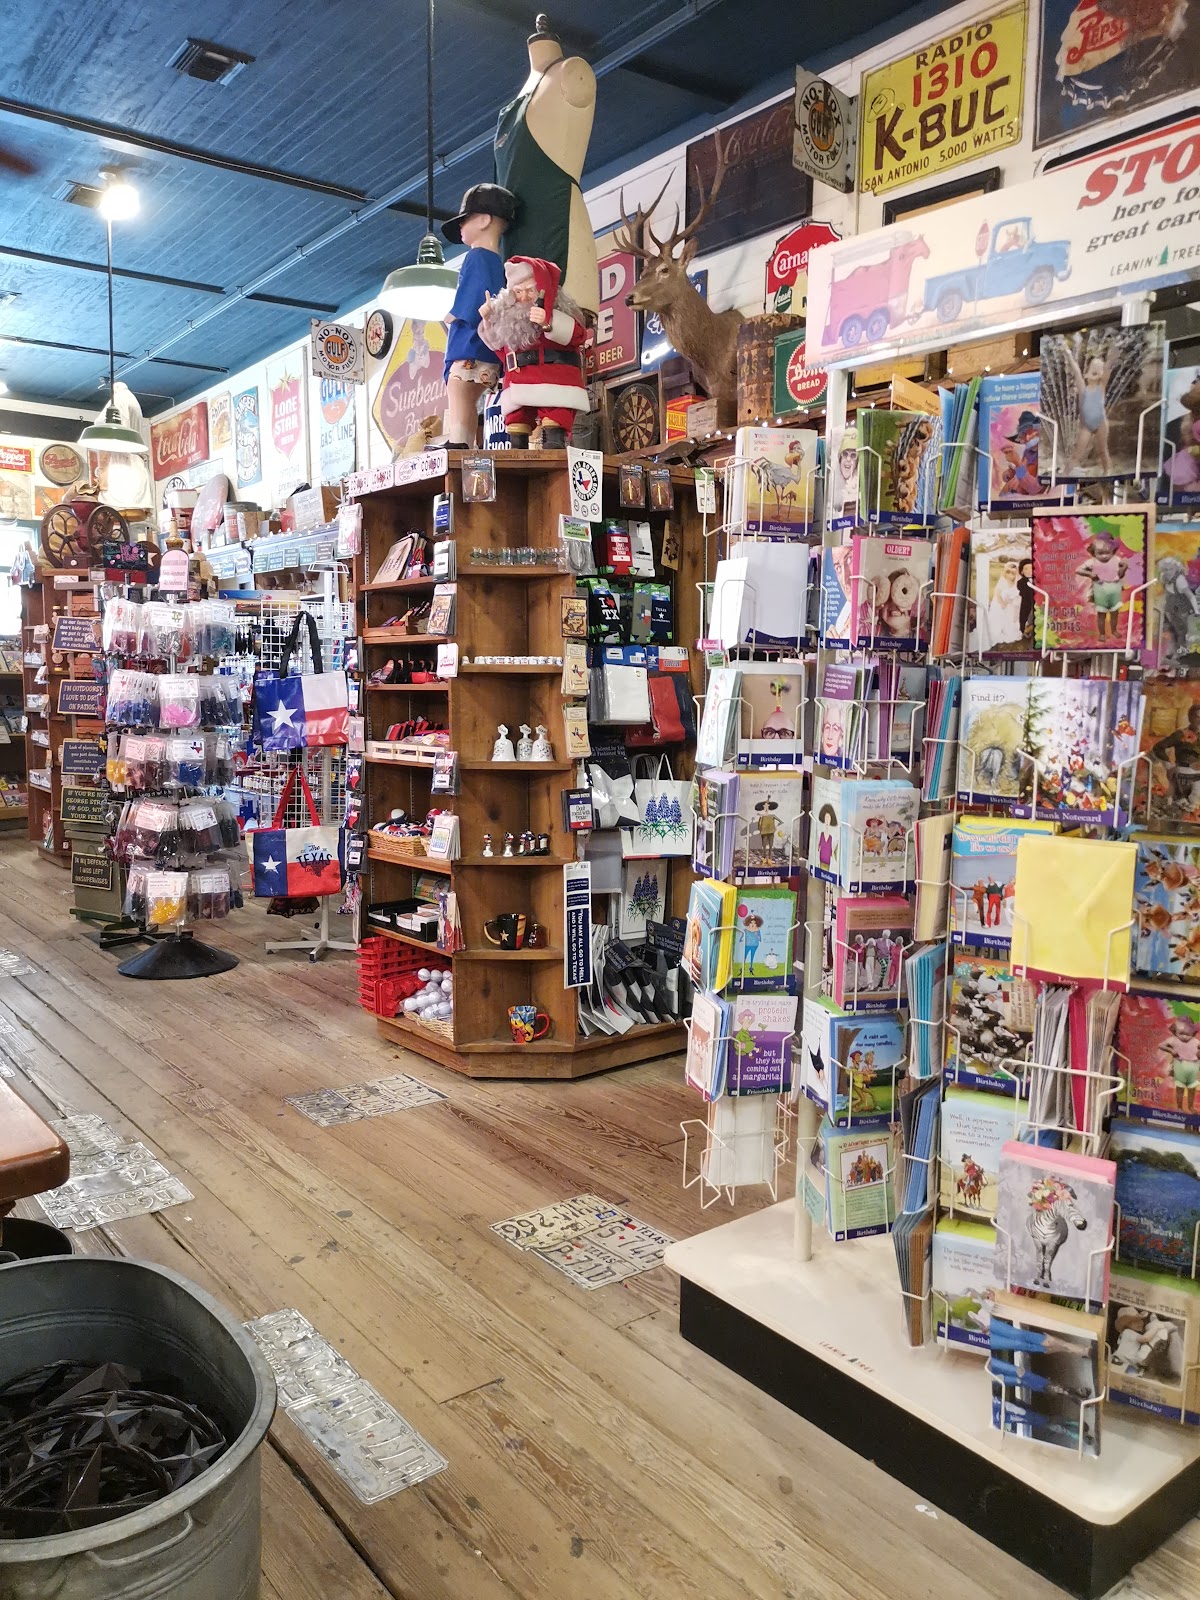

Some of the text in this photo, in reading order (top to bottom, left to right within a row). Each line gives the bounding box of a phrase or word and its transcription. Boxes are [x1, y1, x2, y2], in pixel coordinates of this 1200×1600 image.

[916, 23, 993, 70] RADIO
[913, 41, 998, 108] 1310
[874, 75, 1011, 171] K-BUC
[801, 123, 824, 165] MOTOR
[826, 140, 842, 165] FUEL
[865, 174, 885, 191] SAN
[887, 156, 930, 182] ANTONIO
[973, 121, 1014, 148] WATTS
[1111, 186, 1200, 221] here fo
[1085, 209, 1200, 253] great car
[1110, 244, 1200, 277] LEANIN' TREE
[318, 326, 355, 349] NO-NOX
[325, 340, 346, 359] GULF
[318, 350, 355, 372] MOTOR FUEL
[600, 346, 623, 365] BEER
[797, 379, 821, 392] BREAD
[275, 396, 298, 419] LONE
[275, 413, 298, 436] STAR
[890, 514, 913, 523] Birthday
[886, 545, 911, 555] OLDER?
[598, 597, 606, 608] I
[602, 609, 620, 620] TX
[880, 640, 902, 648] Birthday
[971, 693, 1005, 702] Find it?
[760, 755, 782, 764] Birthday
[990, 796, 1019, 805] Birthda
[1062, 812, 1101, 823] Notecard
[296, 852, 333, 866] TEXAS
[871, 884, 894, 892] Birthday
[572, 943, 577, 952] GO
[579, 949, 584, 957] GO
[572, 952, 577, 960] TO
[579, 958, 584, 966] TO
[753, 979, 775, 987] Birthday
[752, 999, 769, 1007] trying
[865, 1002, 888, 1010] Birthday
[758, 1007, 788, 1015] protein
[763, 1015, 791, 1023] shakes
[746, 1065, 768, 1073] coming
[975, 1076, 1006, 1089] Birthday
[747, 1087, 775, 1095] Friendship
[1152, 1109, 1187, 1123] Birthday
[956, 1123, 970, 1131] that
[972, 1118, 999, 1126] appears
[637, 1225, 669, 1246] TEXAS
[856, 1228, 878, 1237] Birthday
[584, 1244, 617, 1264] TEXAS
